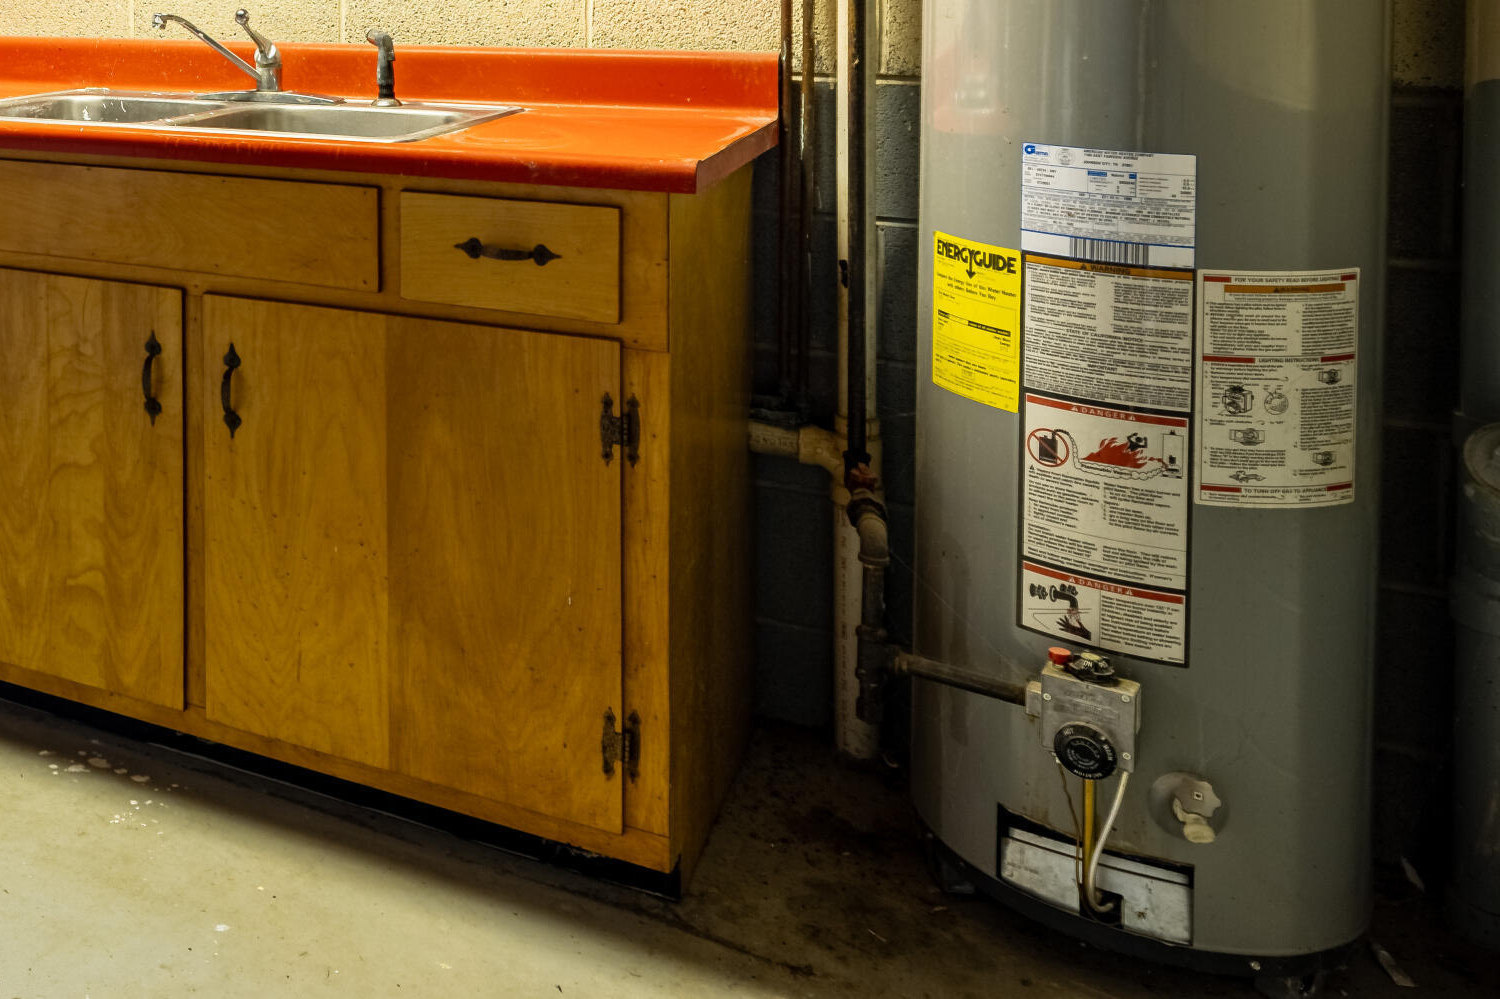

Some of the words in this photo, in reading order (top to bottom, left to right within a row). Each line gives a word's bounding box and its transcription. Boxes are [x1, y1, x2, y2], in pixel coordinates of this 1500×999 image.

[1090, 264, 1131, 275] WARNING
[1081, 407, 1126, 419] DANGER
[1078, 578, 1123, 594] DANGER
